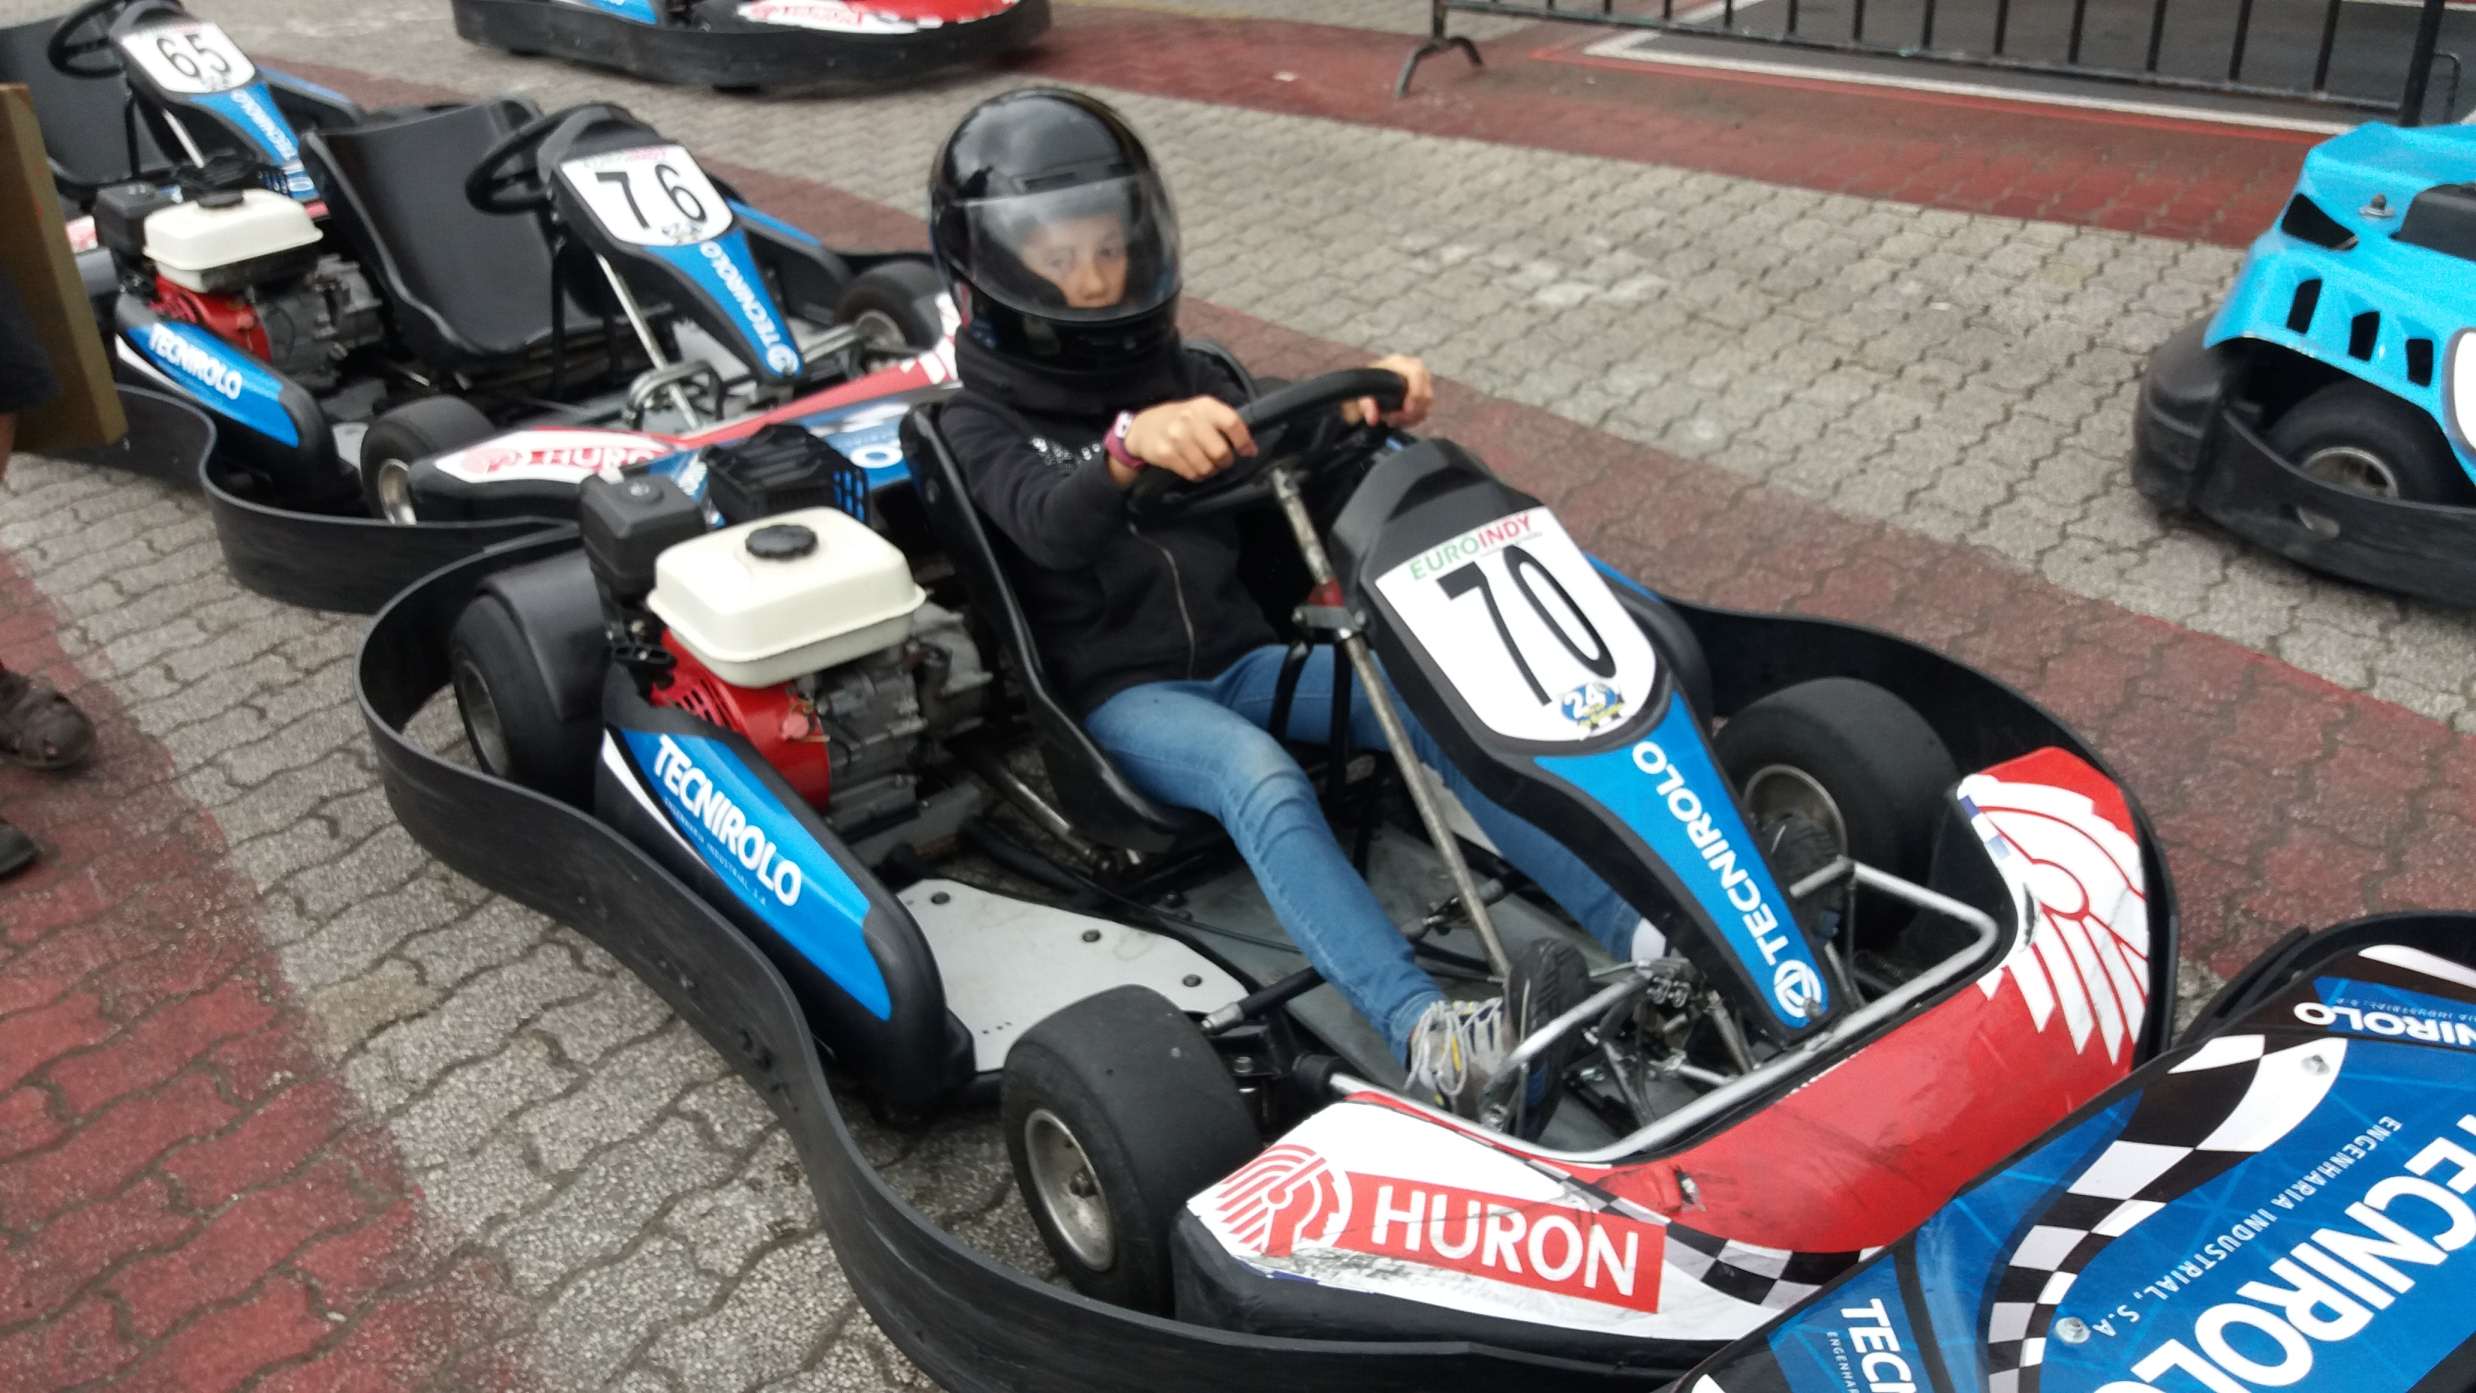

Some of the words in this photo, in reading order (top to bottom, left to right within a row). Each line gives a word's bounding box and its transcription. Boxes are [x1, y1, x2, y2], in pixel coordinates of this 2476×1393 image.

[156, 33, 232, 78] 65
[595, 164, 708, 230] 76
[150, 323, 242, 399] TECNIROLO
[1409, 515, 1532, 581] EUROINDY
[1436, 545, 1616, 706] 70
[654, 734, 802, 907] TECNIROLO
[1632, 741, 1791, 968] TECNIROLO
[2271, 1116, 2402, 1210] ENGENHARIA
[1371, 1184, 1639, 1297] HURON
[2093, 1114, 2476, 1393] ECNIROL
[2133, 1208, 2278, 1301] INDUSTRIAL,
